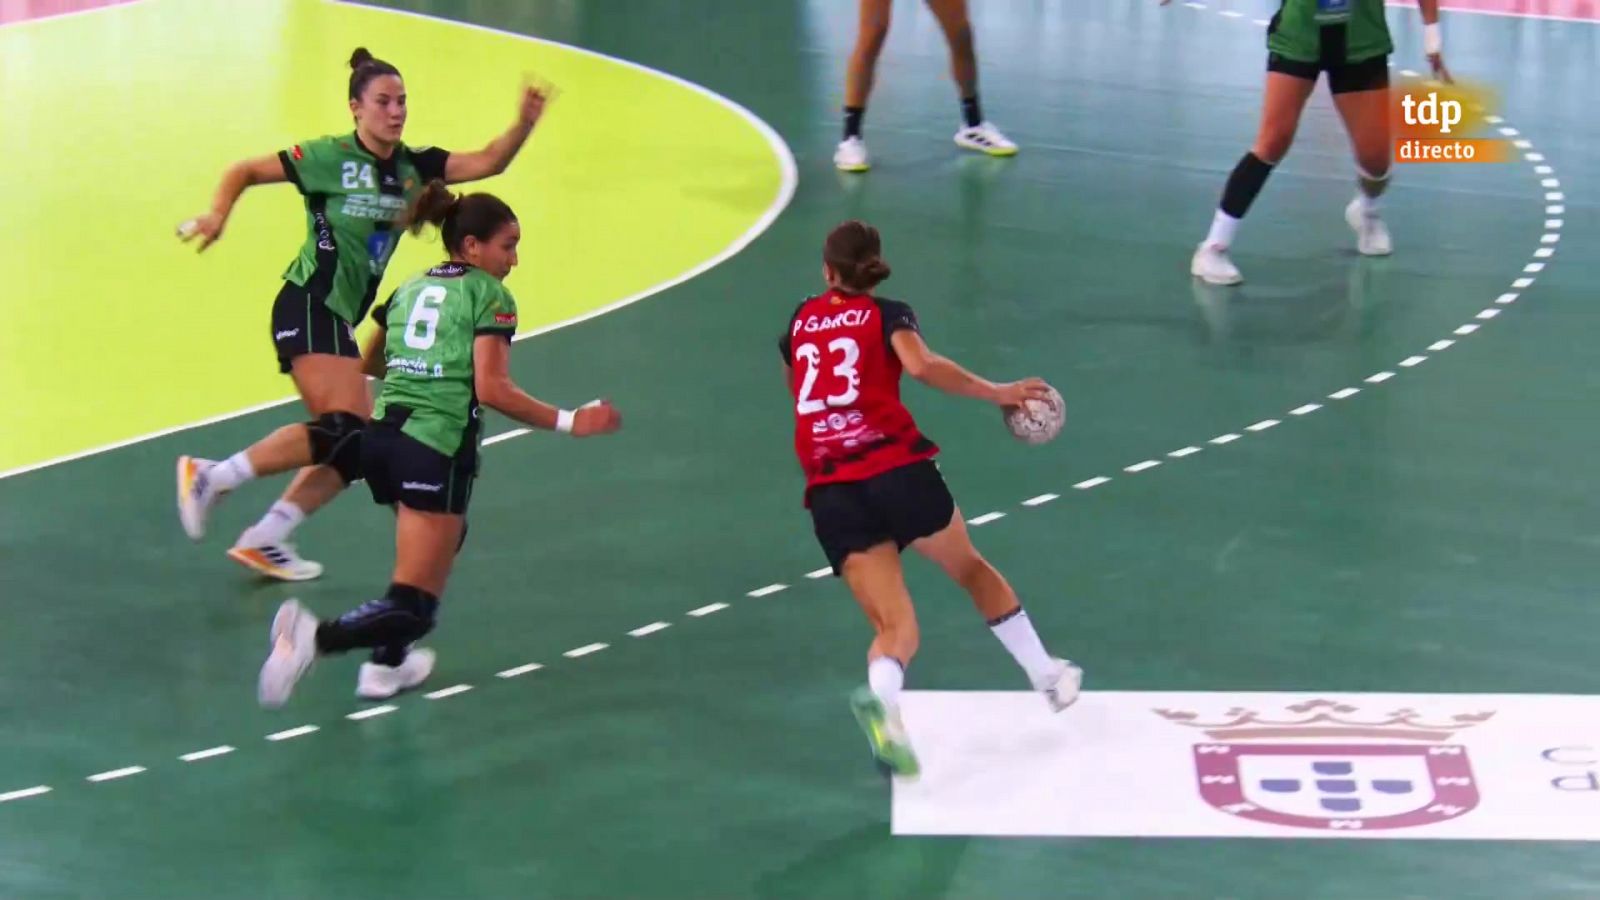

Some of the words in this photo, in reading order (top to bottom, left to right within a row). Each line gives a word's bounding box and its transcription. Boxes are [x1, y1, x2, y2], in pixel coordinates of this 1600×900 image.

[342, 161, 374, 189] 24
[404, 286, 447, 350] 6
[793, 319, 802, 336] P
[796, 337, 860, 415] 23
